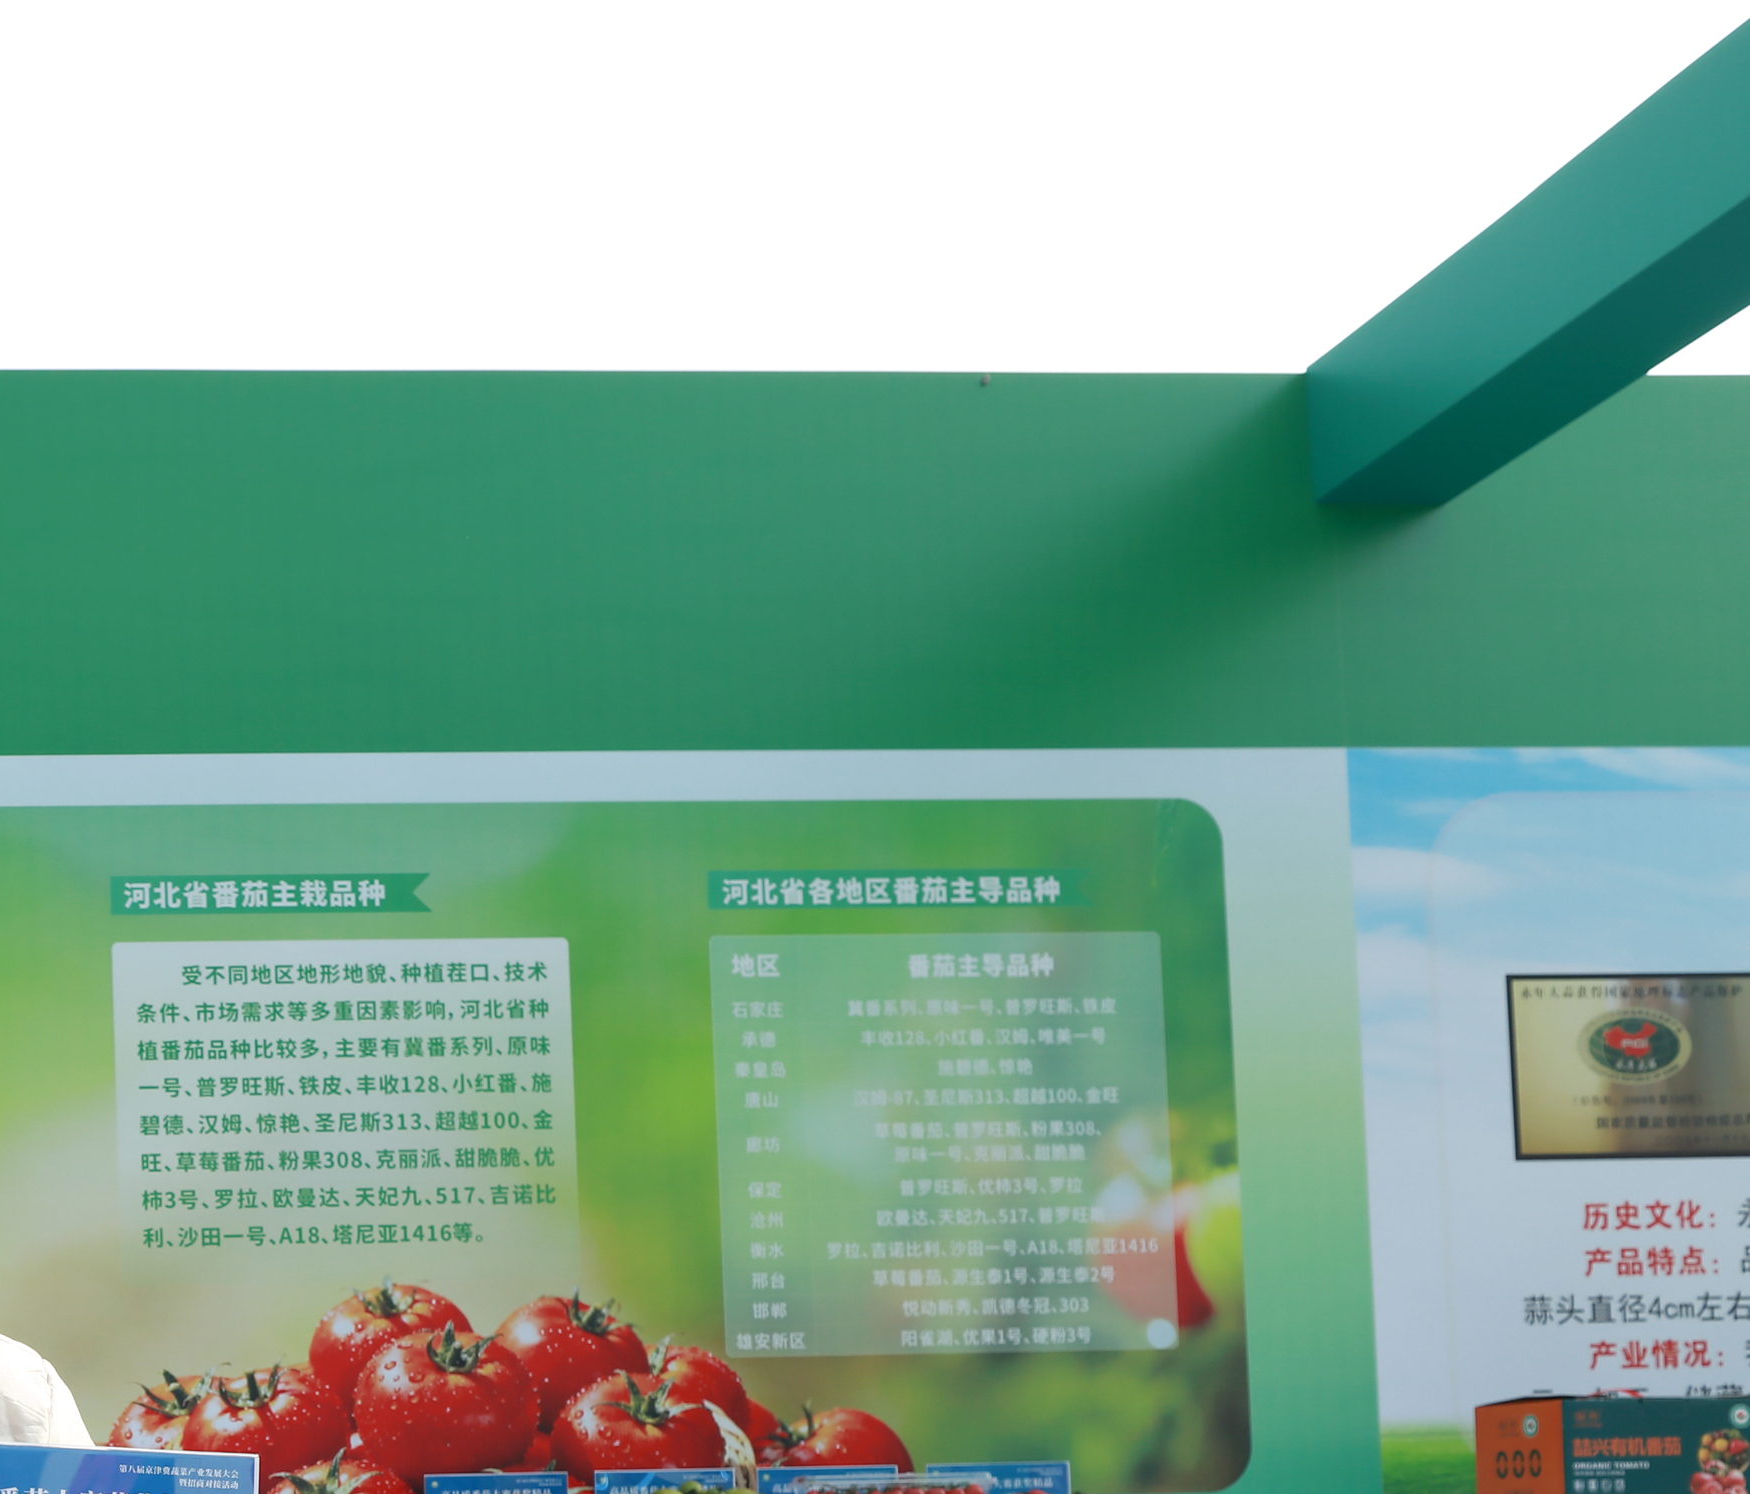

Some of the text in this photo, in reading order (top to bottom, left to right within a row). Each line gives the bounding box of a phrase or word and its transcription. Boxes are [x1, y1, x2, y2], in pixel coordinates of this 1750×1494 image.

[123, 880, 386, 909] 河北省番茄主栽品种
[722, 876, 1061, 906] 河北省各地区番茄主导品种
[181, 961, 548, 987] 受不同地区地形地貌、种植茬口、技术
[731, 953, 780, 978] 地区
[908, 953, 1055, 979] 番茄主导品种
[136, 998, 550, 1024] 条件、市场需求等多重因素影响，河北省种
[731, 1000, 784, 1019] 石家庄
[137, 1035, 551, 1061] 植番茄品种比较多，主要有冀番系列、原味
[741, 1030, 777, 1049] 承德
[734, 1060, 786, 1079] 秦皇岛
[138, 1072, 553, 1098] 一号、普罗旺斯、铁皮、丰收128、小红番、施
[744, 1091, 779, 1110] 唐山
[139, 1109, 554, 1136] 碧德、汉姆、惊艳、圣尼斯313、超越100、金
[745, 1135, 781, 1155] 廊坊
[140, 1146, 556, 1173] 旺、草莓番茄、粉果308、克丽派、甜脆脆、优
[142, 1183, 557, 1211] 柿3号、罗拉、欧曼达、天妃九、517、吉诺比
[747, 1181, 783, 1199] 保定
[749, 1211, 785, 1229] 沧州
[143, 1221, 484, 1249] 利、沙田一号、A18、塔尼亚1416等。
[749, 1241, 785, 1260] 衡水
[751, 1272, 786, 1290] 邢台
[752, 1302, 788, 1320] 邯郸
[736, 1331, 807, 1352] 雄安新区
[1590, 1340, 1750, 1370] 产业情况：
[119, 1464, 239, 1479] 第八届京津冀蔬菜产业发展大会
[1573, 1460, 1650, 1471] ORGANIC TOMATO
[178, 1478, 239, 1490] 暨招商对接活动
